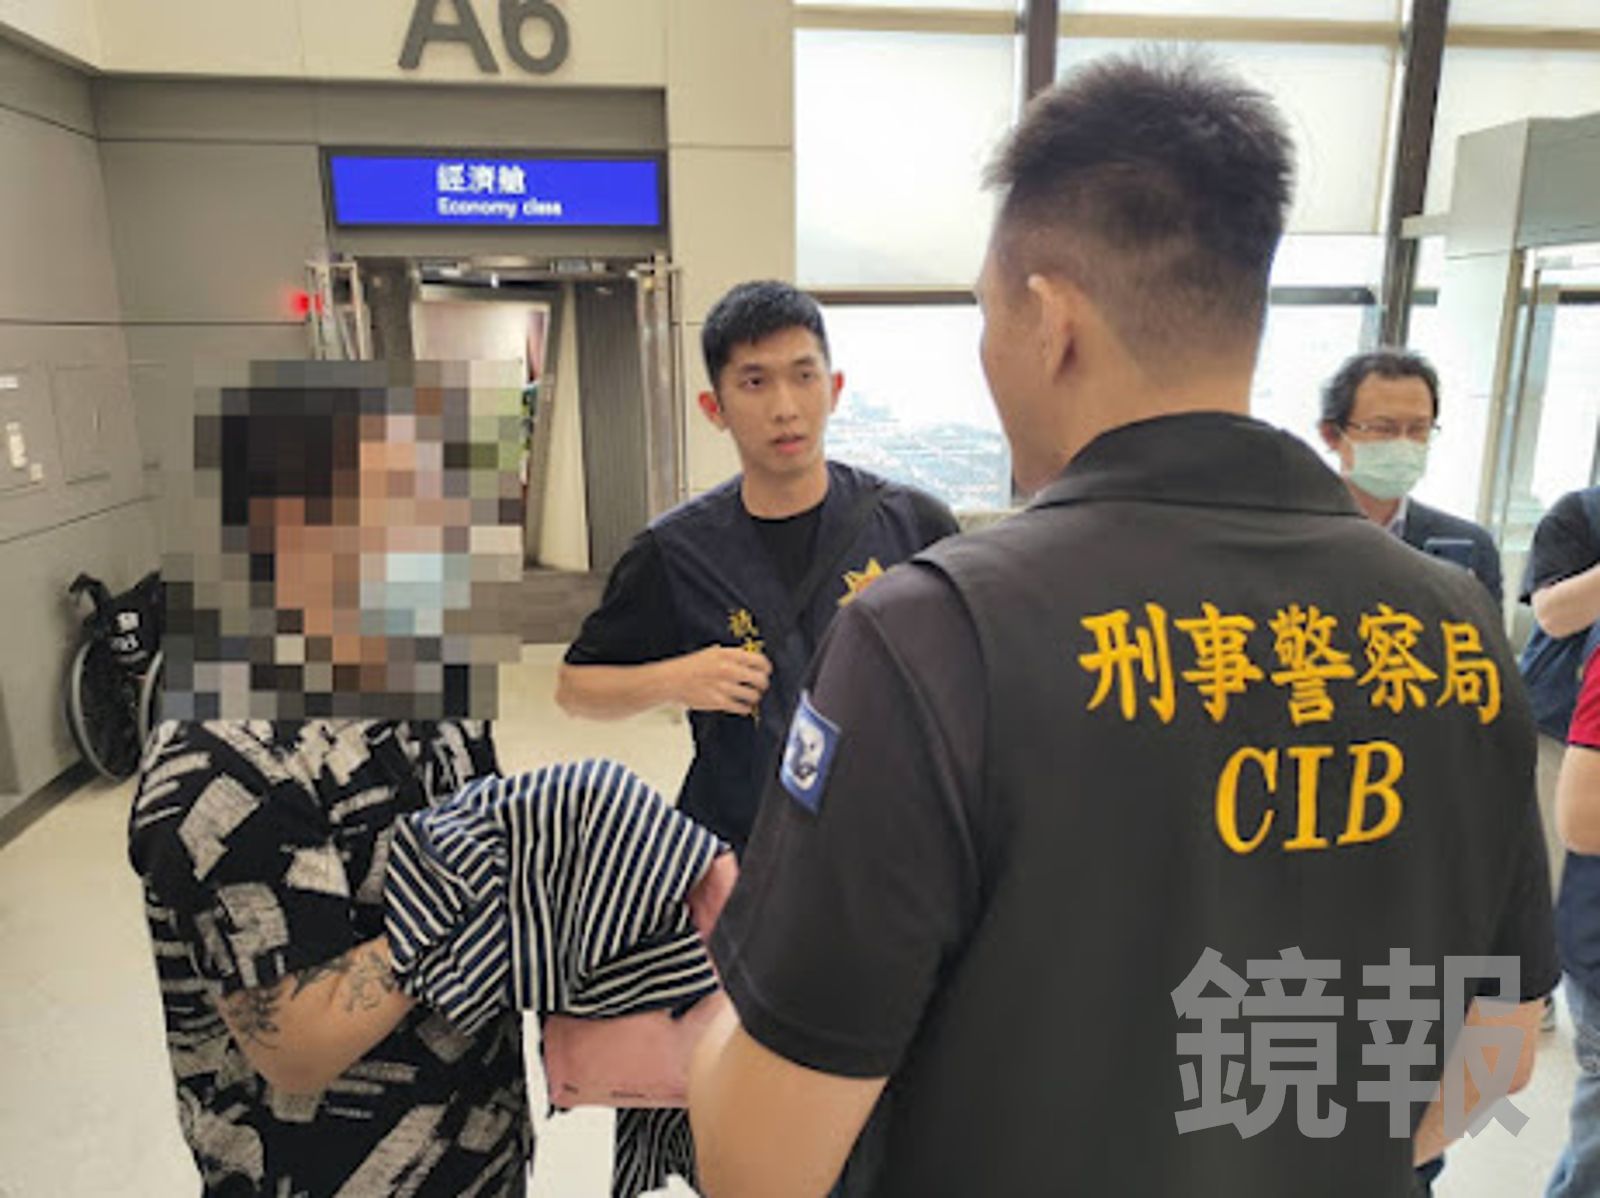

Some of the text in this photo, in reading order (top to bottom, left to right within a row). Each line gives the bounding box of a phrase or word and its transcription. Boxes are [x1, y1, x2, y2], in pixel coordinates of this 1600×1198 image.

[398, 0, 570, 76] A6
[437, 197, 562, 219] Economy class
[1078, 602, 1502, 726] 刑事警察局
[1214, 740, 1405, 855] CIB
